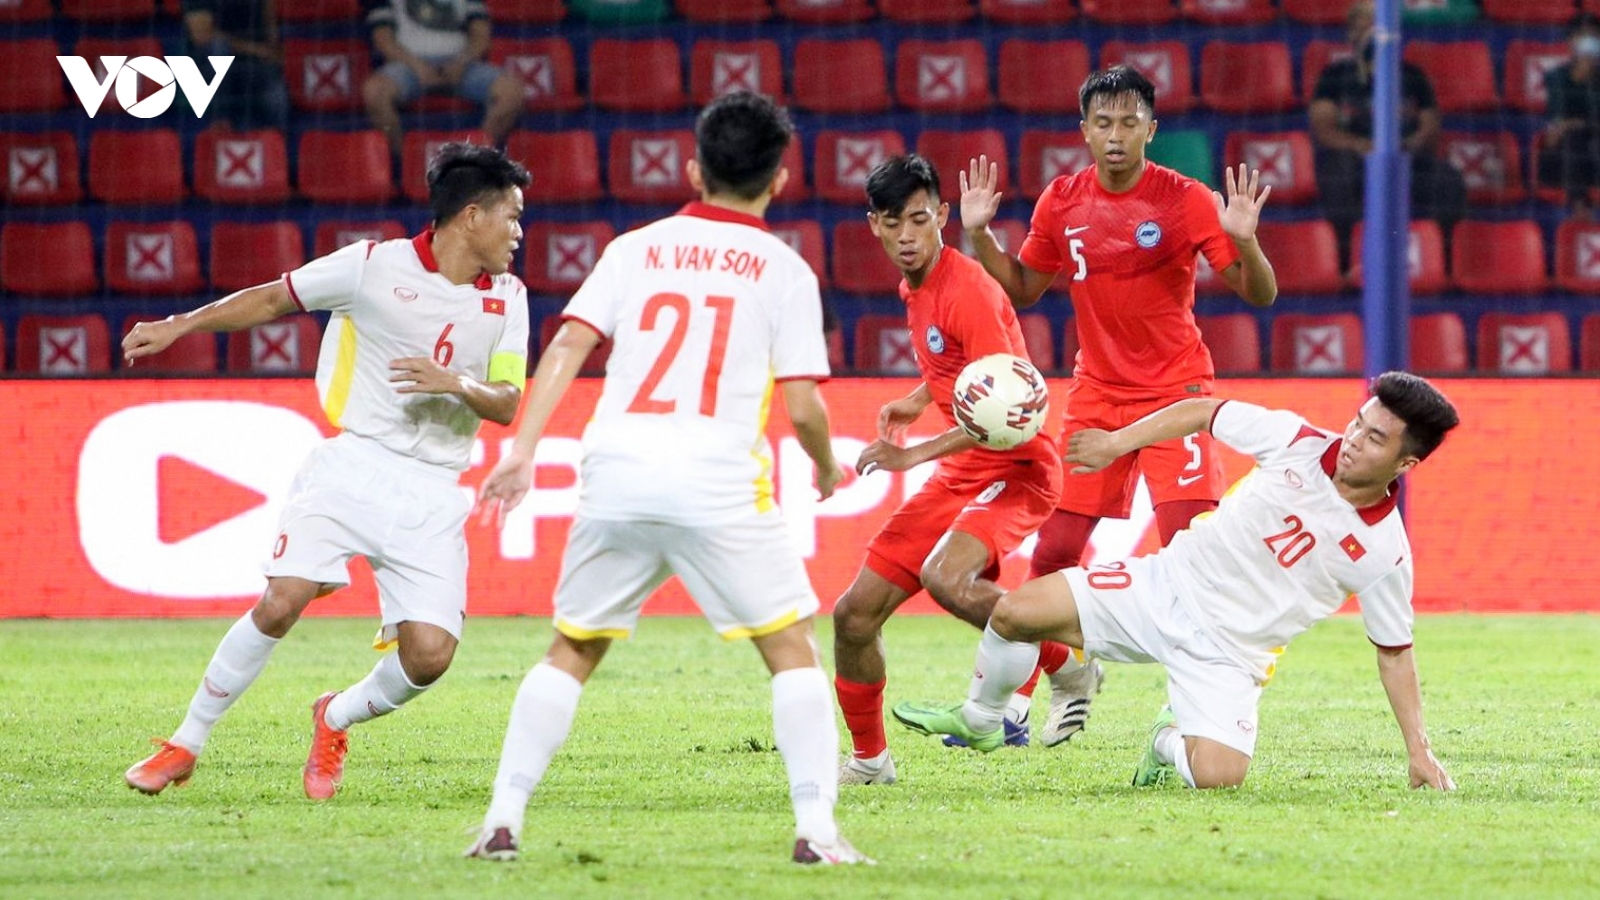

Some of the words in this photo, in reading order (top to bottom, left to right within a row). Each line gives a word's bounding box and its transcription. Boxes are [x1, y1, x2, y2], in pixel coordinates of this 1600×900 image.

[644, 244, 664, 270] N.
[674, 244, 717, 271] VAN
[719, 247, 767, 282] SON
[1069, 238, 1088, 281] 5
[433, 322, 455, 369] 6
[625, 291, 735, 418] 21
[1182, 431, 1202, 471] 5
[1262, 513, 1317, 569] 20
